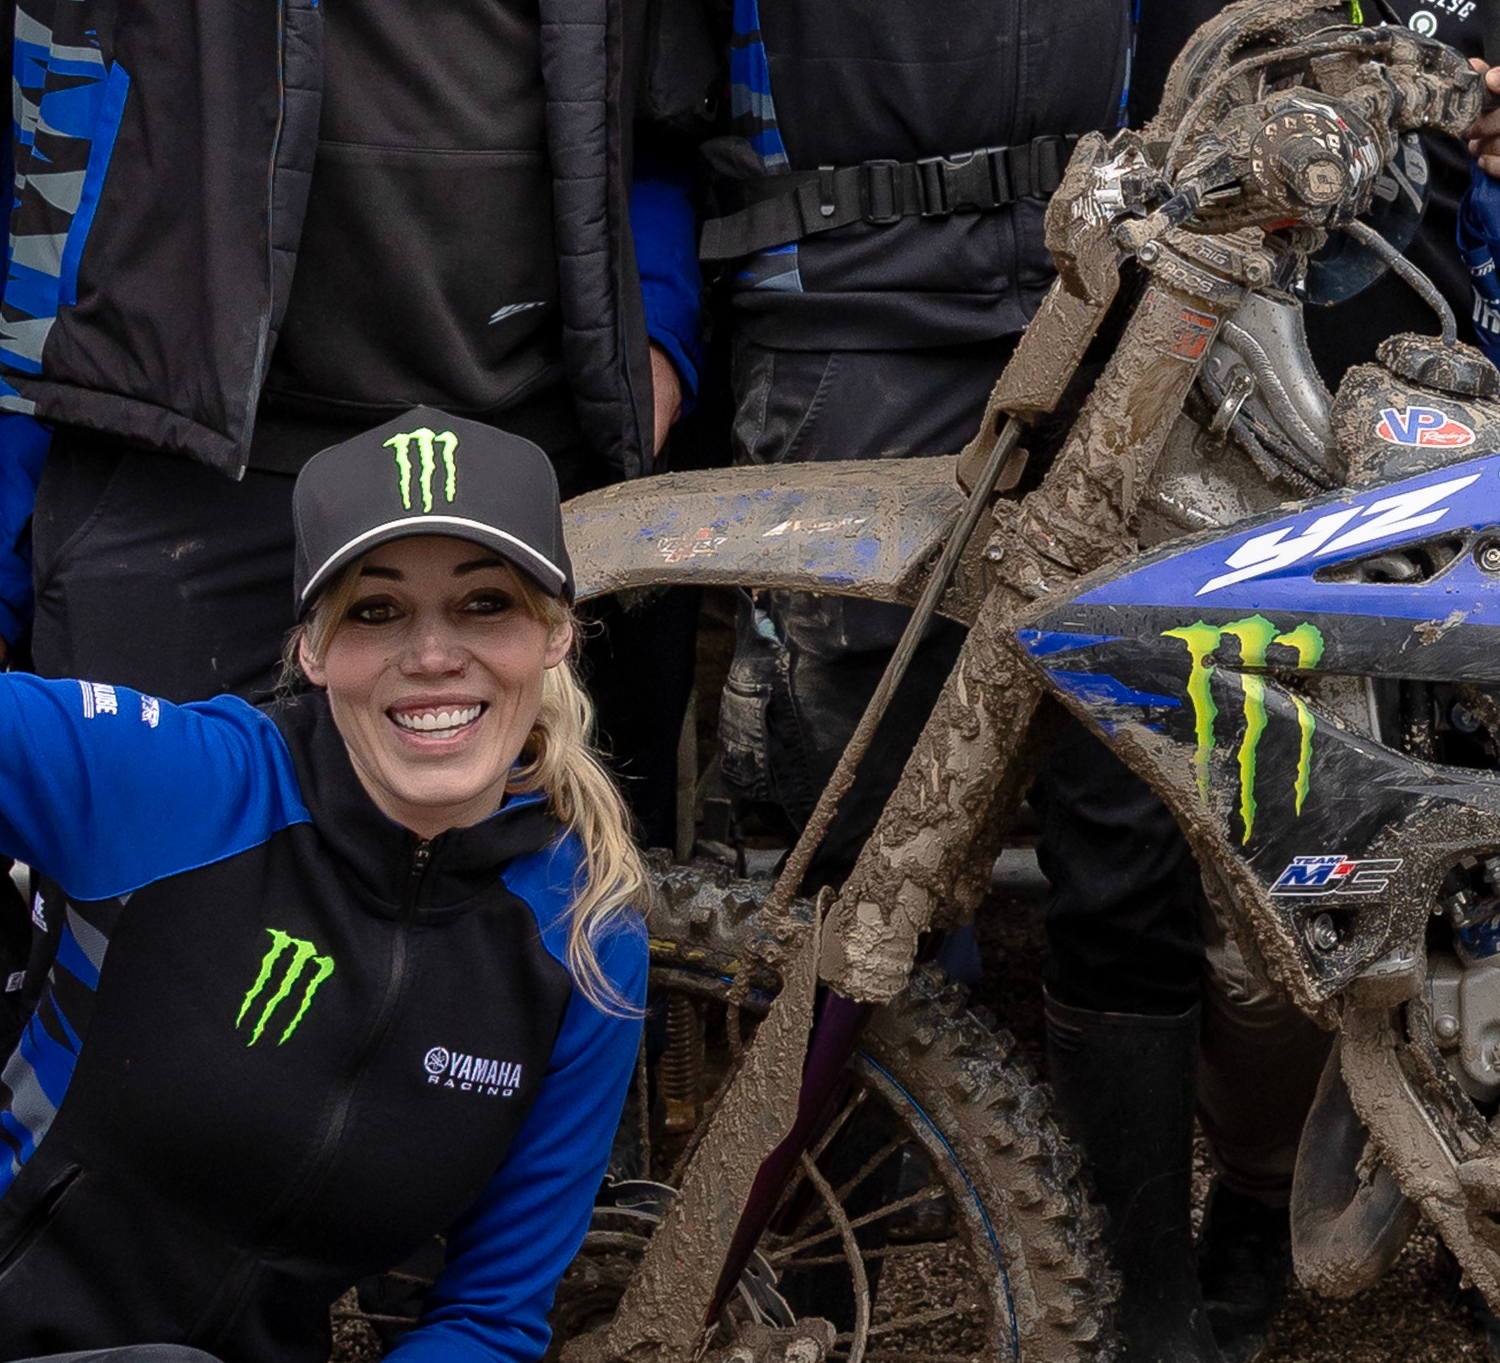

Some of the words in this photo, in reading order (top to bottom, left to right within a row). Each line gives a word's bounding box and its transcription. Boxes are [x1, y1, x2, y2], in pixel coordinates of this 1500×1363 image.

[1380, 406, 1447, 446] VP
[1422, 430, 1471, 443] Racing
[1195, 474, 1481, 596] YZ
[1293, 857, 1347, 865] TEAM
[449, 1052, 522, 1088] YAMAHA
[428, 1074, 513, 1097] RACING
